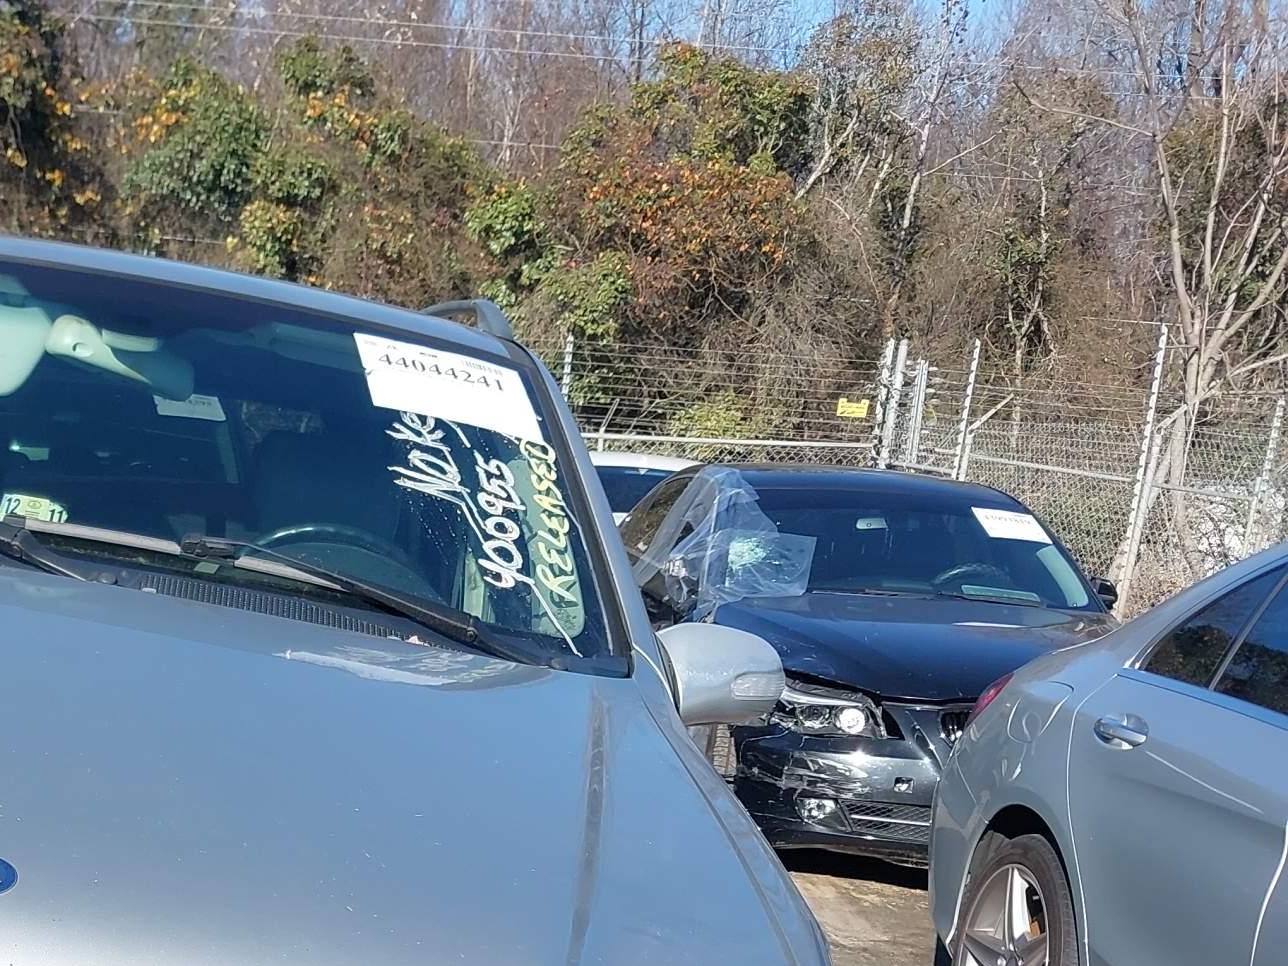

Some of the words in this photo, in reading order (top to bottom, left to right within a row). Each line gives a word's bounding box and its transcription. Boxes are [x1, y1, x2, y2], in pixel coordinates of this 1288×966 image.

[378, 353, 504, 391] 44044241
[5, 498, 21, 514] 12
[49, 508, 64, 522] 11
[476, 450, 535, 588] 400955
[519, 438, 579, 602] RELEASED
